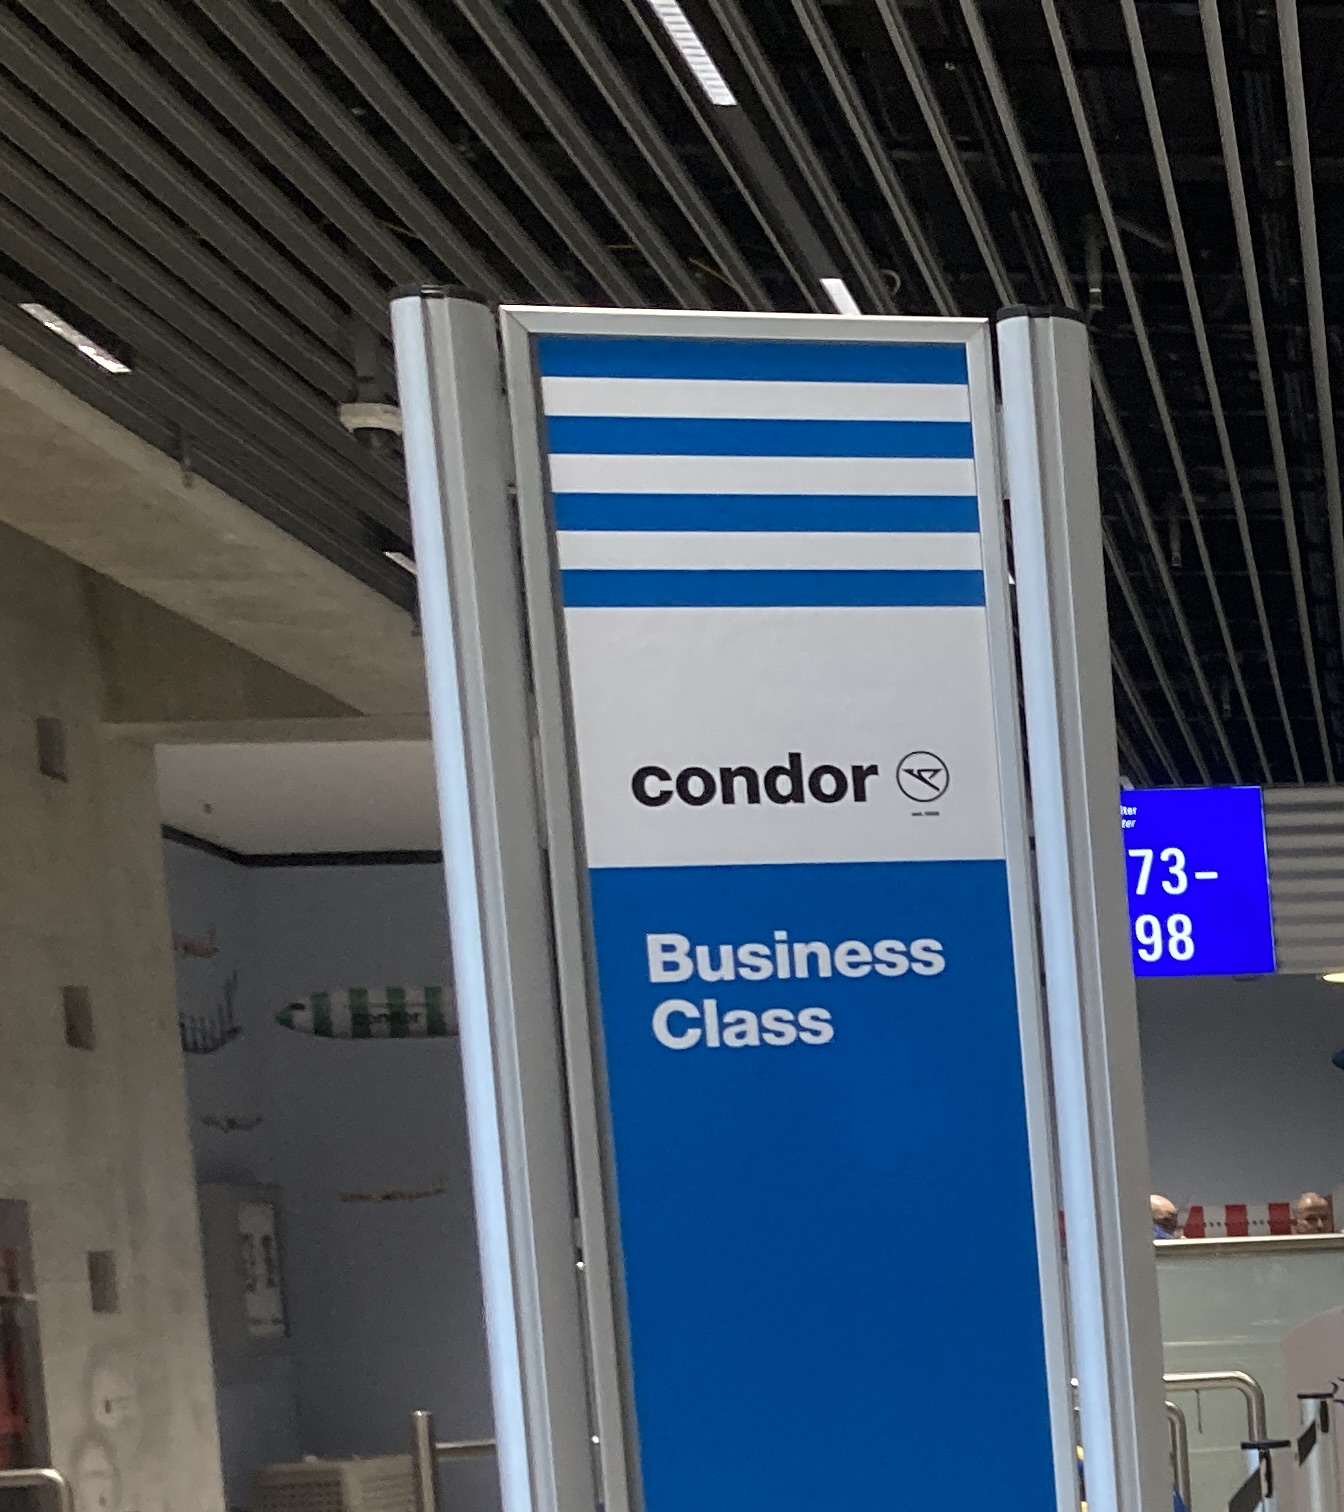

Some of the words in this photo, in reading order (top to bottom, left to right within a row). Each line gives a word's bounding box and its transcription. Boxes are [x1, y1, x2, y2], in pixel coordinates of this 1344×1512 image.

[632, 752, 878, 807] condor
[1128, 847, 1219, 895] 73-
[646, 930, 946, 983] Business
[1135, 914, 1195, 962] 98
[652, 998, 835, 1050] Class
